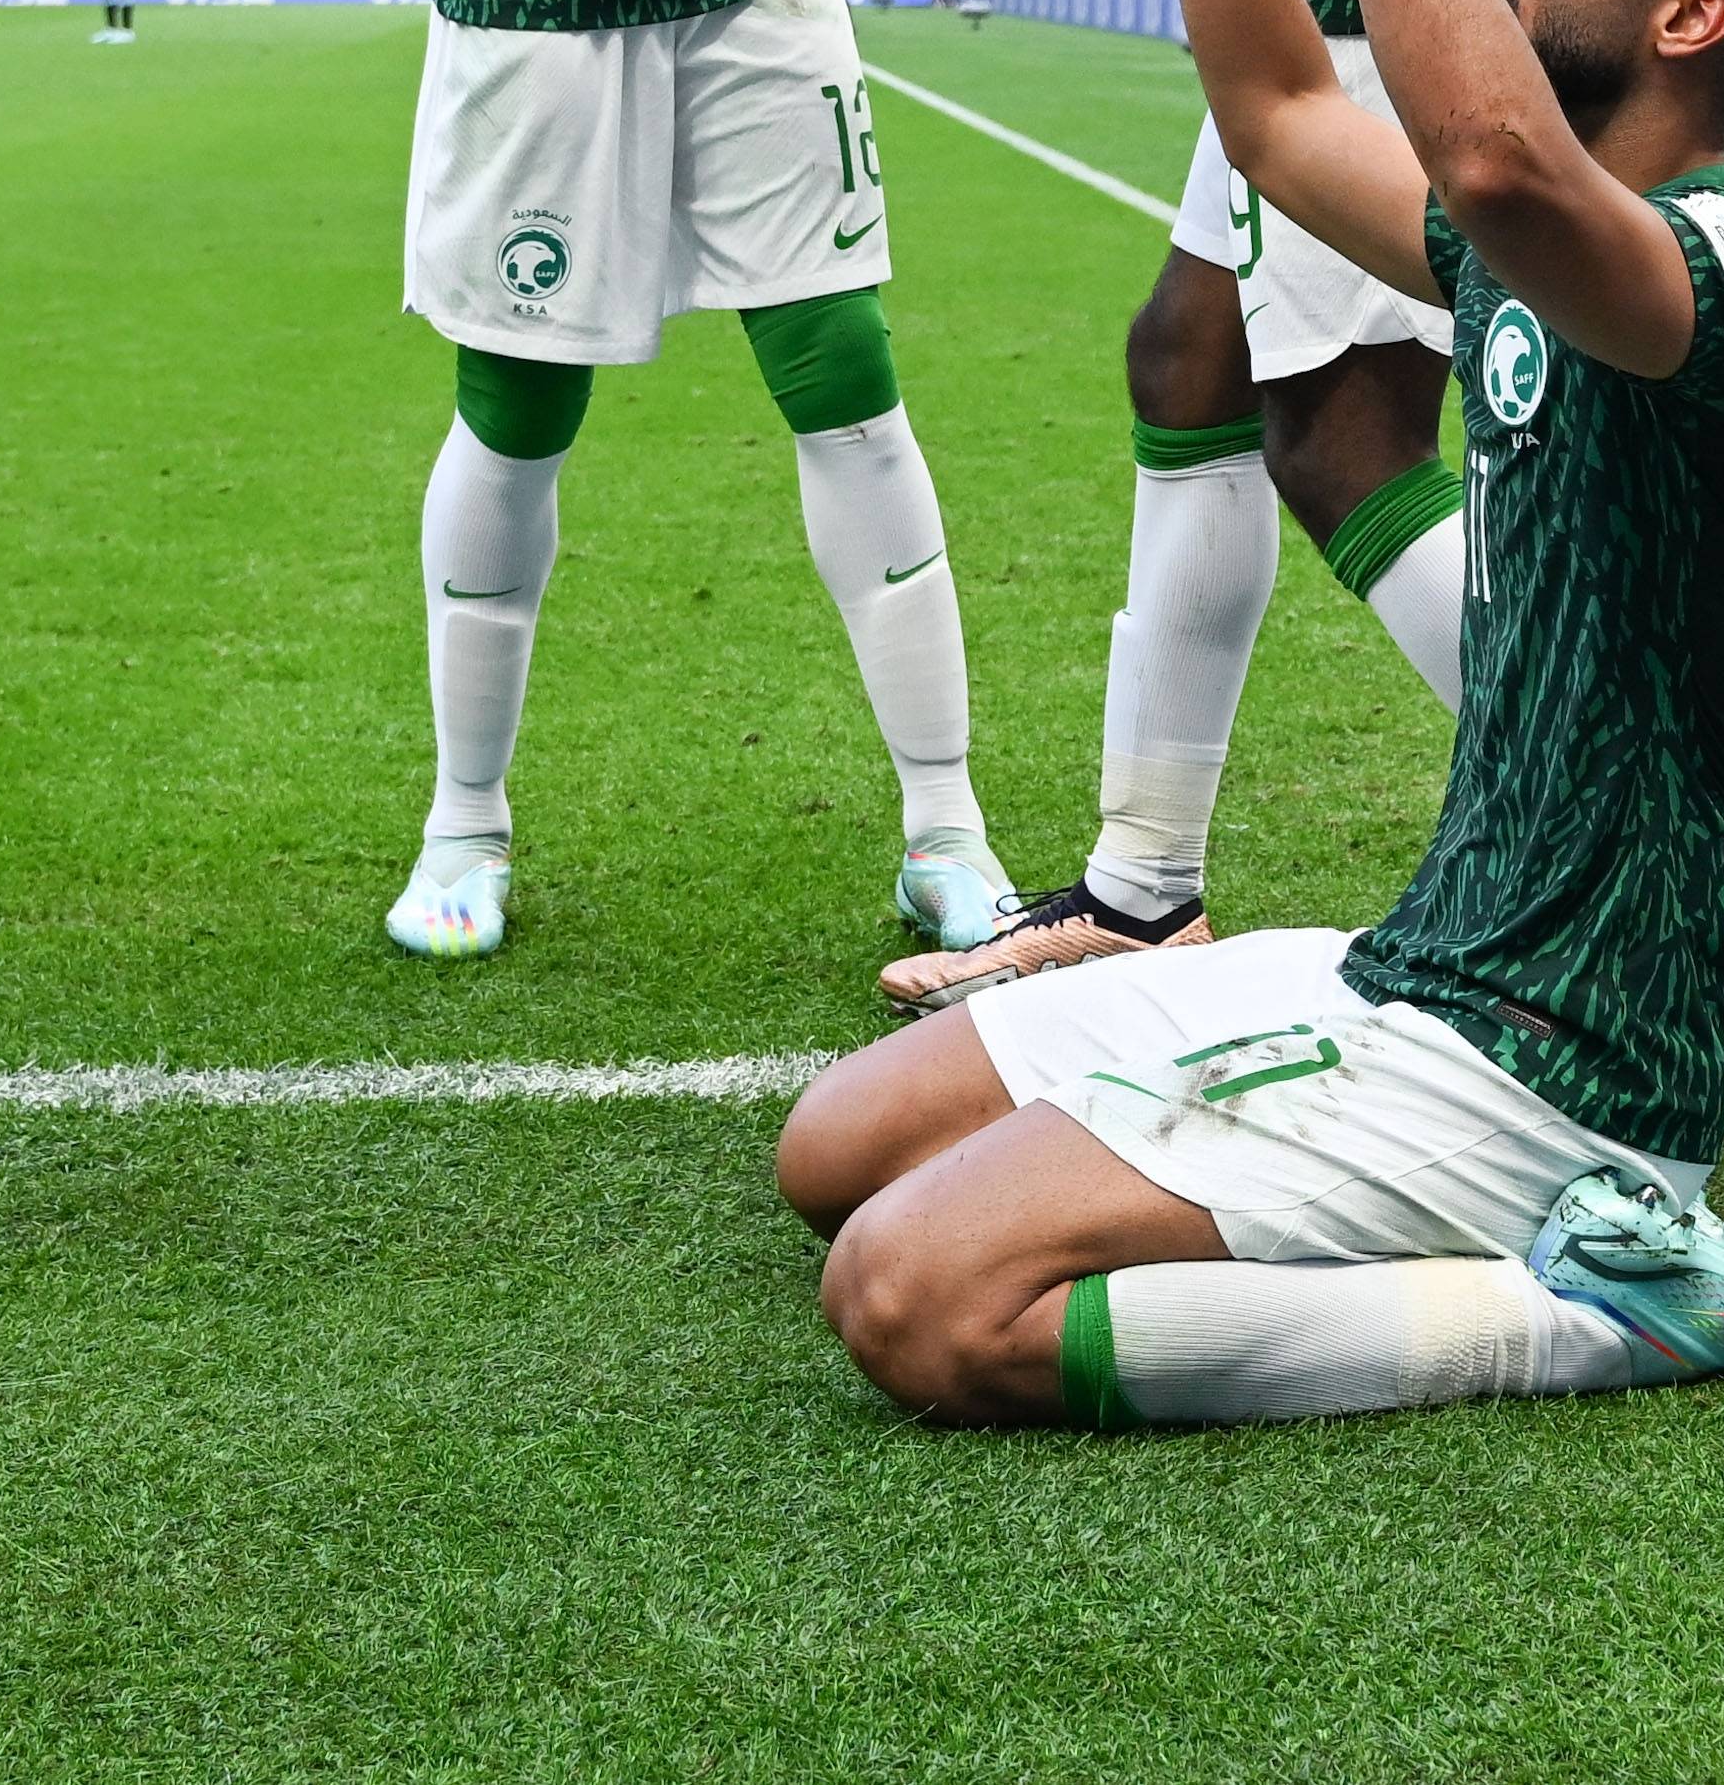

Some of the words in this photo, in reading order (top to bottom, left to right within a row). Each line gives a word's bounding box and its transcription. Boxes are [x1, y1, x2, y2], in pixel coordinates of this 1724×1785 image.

[513, 303, 548, 316] KSA
[1514, 372, 1534, 386] SAFF
[1471, 449, 1491, 603] 11
